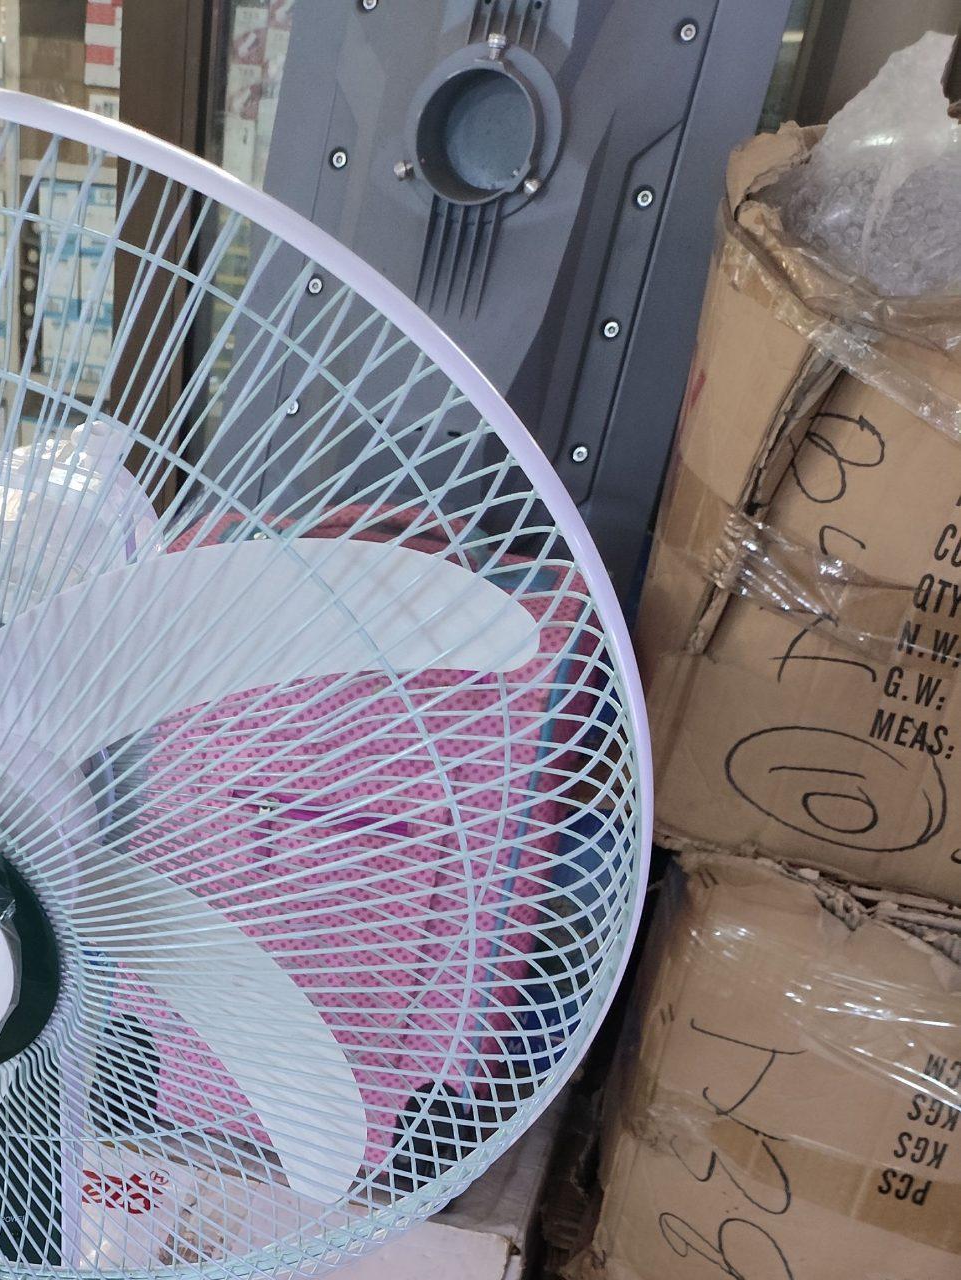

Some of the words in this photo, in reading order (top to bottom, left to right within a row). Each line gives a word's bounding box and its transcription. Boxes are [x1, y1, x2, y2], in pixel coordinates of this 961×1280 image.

[883, 666, 946, 711] G.W:
[868, 708, 955, 760] MEAS:
[907, 1093, 961, 1133] KGS
[893, 1131, 949, 1170] KGS
[877, 1167, 933, 1207] PCS
